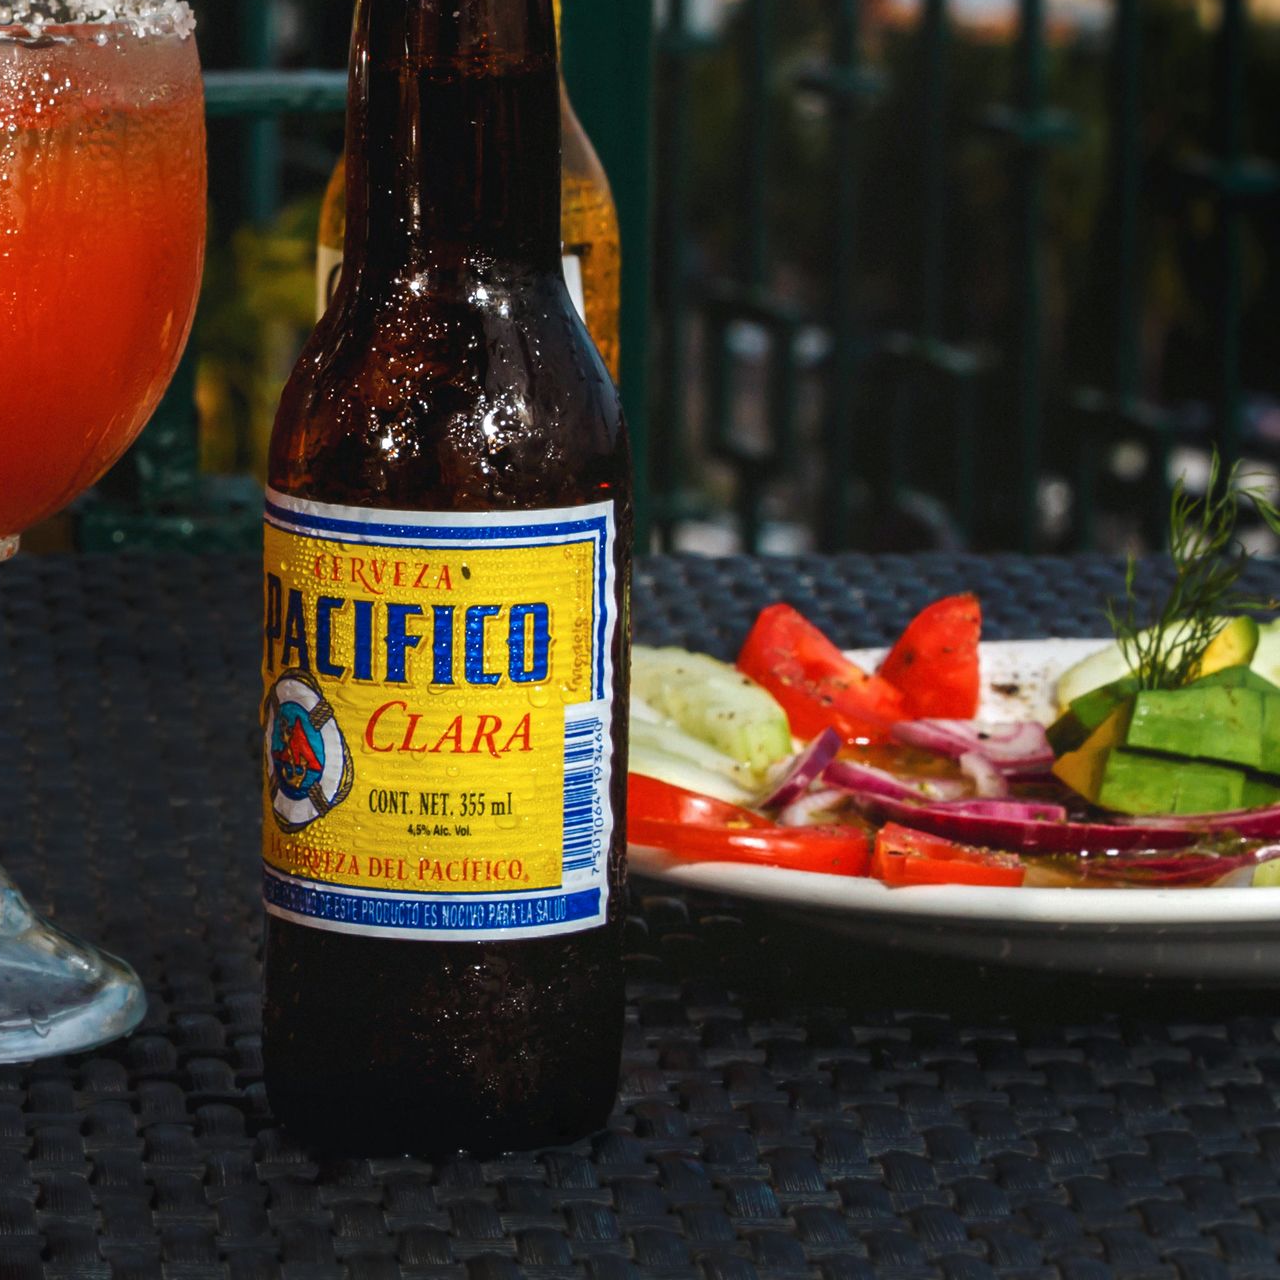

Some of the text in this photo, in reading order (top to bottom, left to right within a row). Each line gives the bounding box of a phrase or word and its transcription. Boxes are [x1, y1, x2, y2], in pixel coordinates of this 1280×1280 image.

[313, 554, 454, 595] CERVEZA
[267, 572, 553, 686] PACIFICO
[369, 788, 513, 817] CONT. NET. 355 ml
[433, 824, 452, 837] Alc.
[454, 824, 473, 837] Vol.
[285, 842, 360, 876] CERVEZA
[368, 856, 409, 881] DEL
[334, 896, 358, 921] ESTE
[361, 900, 419, 926] PRODUCTO
[424, 904, 438, 927] ES
[442, 904, 485, 928] NOCIVO
[488, 902, 517, 927] PARA
[520, 901, 533, 924] LA
[536, 895, 567, 923] SALUD
